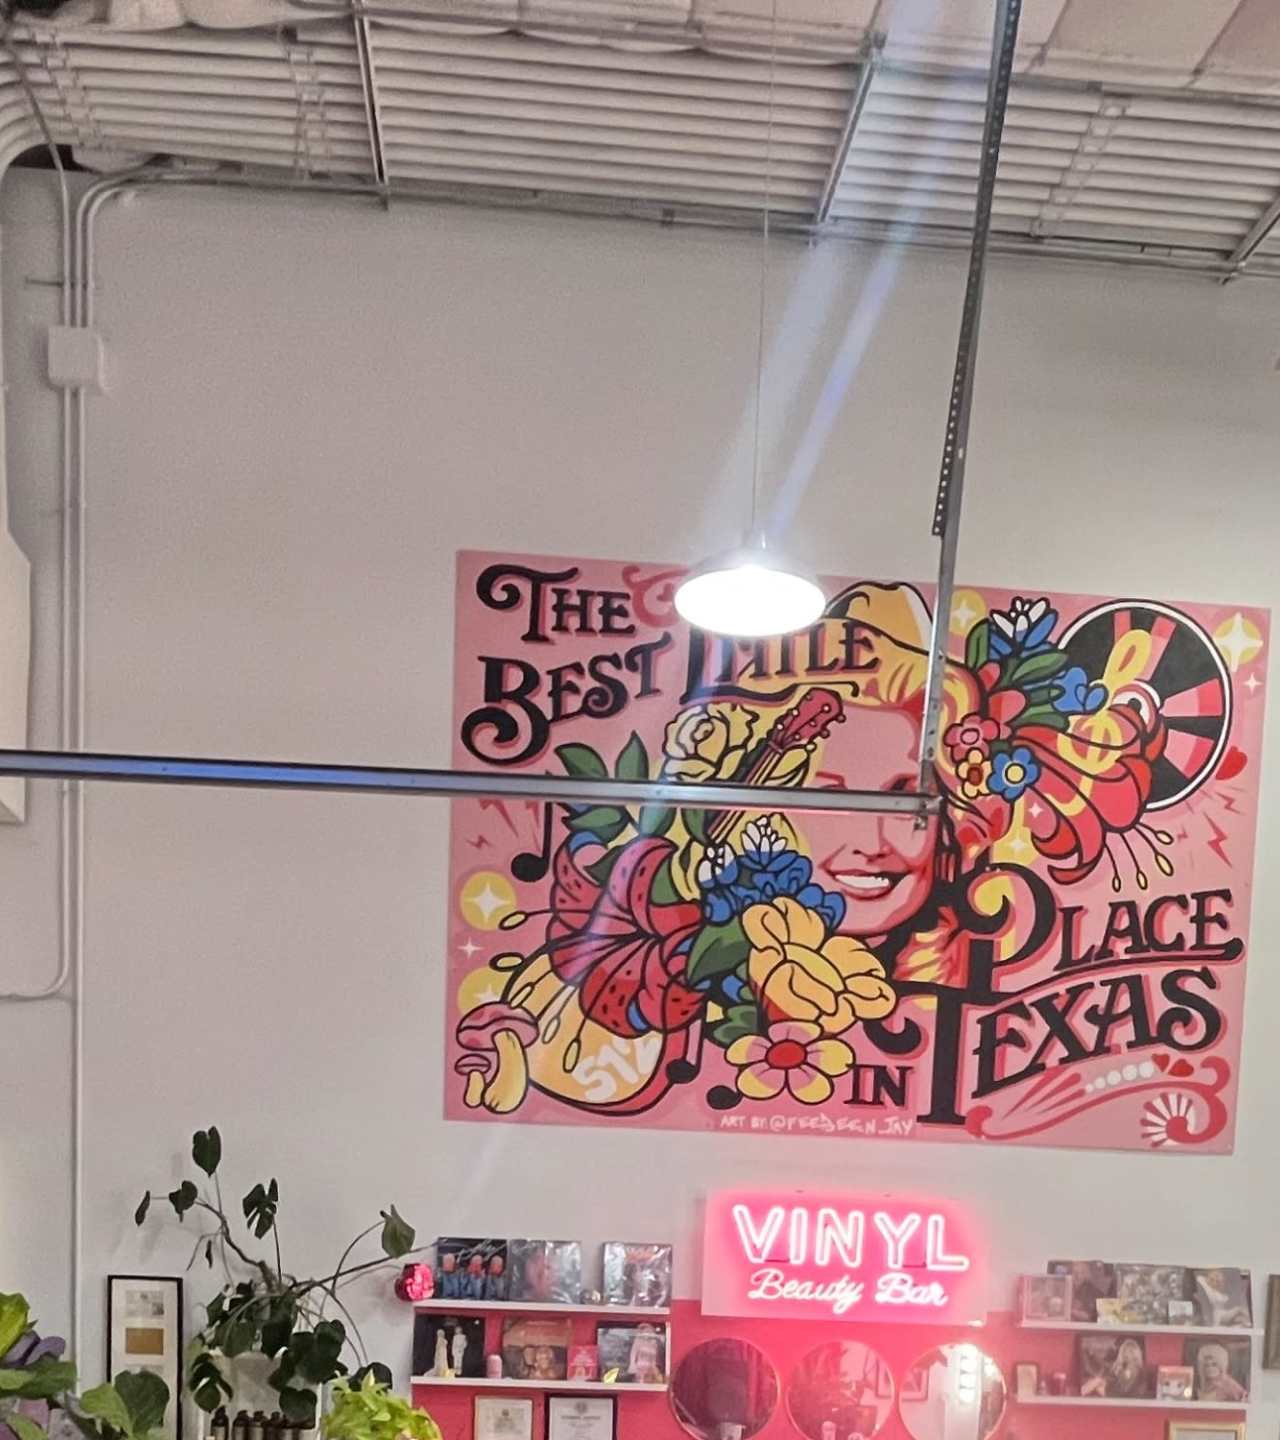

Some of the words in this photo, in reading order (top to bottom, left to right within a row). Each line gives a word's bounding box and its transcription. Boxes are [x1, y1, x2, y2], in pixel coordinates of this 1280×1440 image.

[476, 565, 636, 643] THE
[461, 633, 672, 766] BEST
[958, 862, 1244, 1000] PLACE
[865, 970, 1224, 1125] TEXAS
[720, 1114, 746, 1128] ART
[847, 1064, 913, 1108] IN
[732, 1204, 970, 1271] VINYL
[747, 1268, 865, 1315] Beauty
[874, 1272, 948, 1306] Bar
